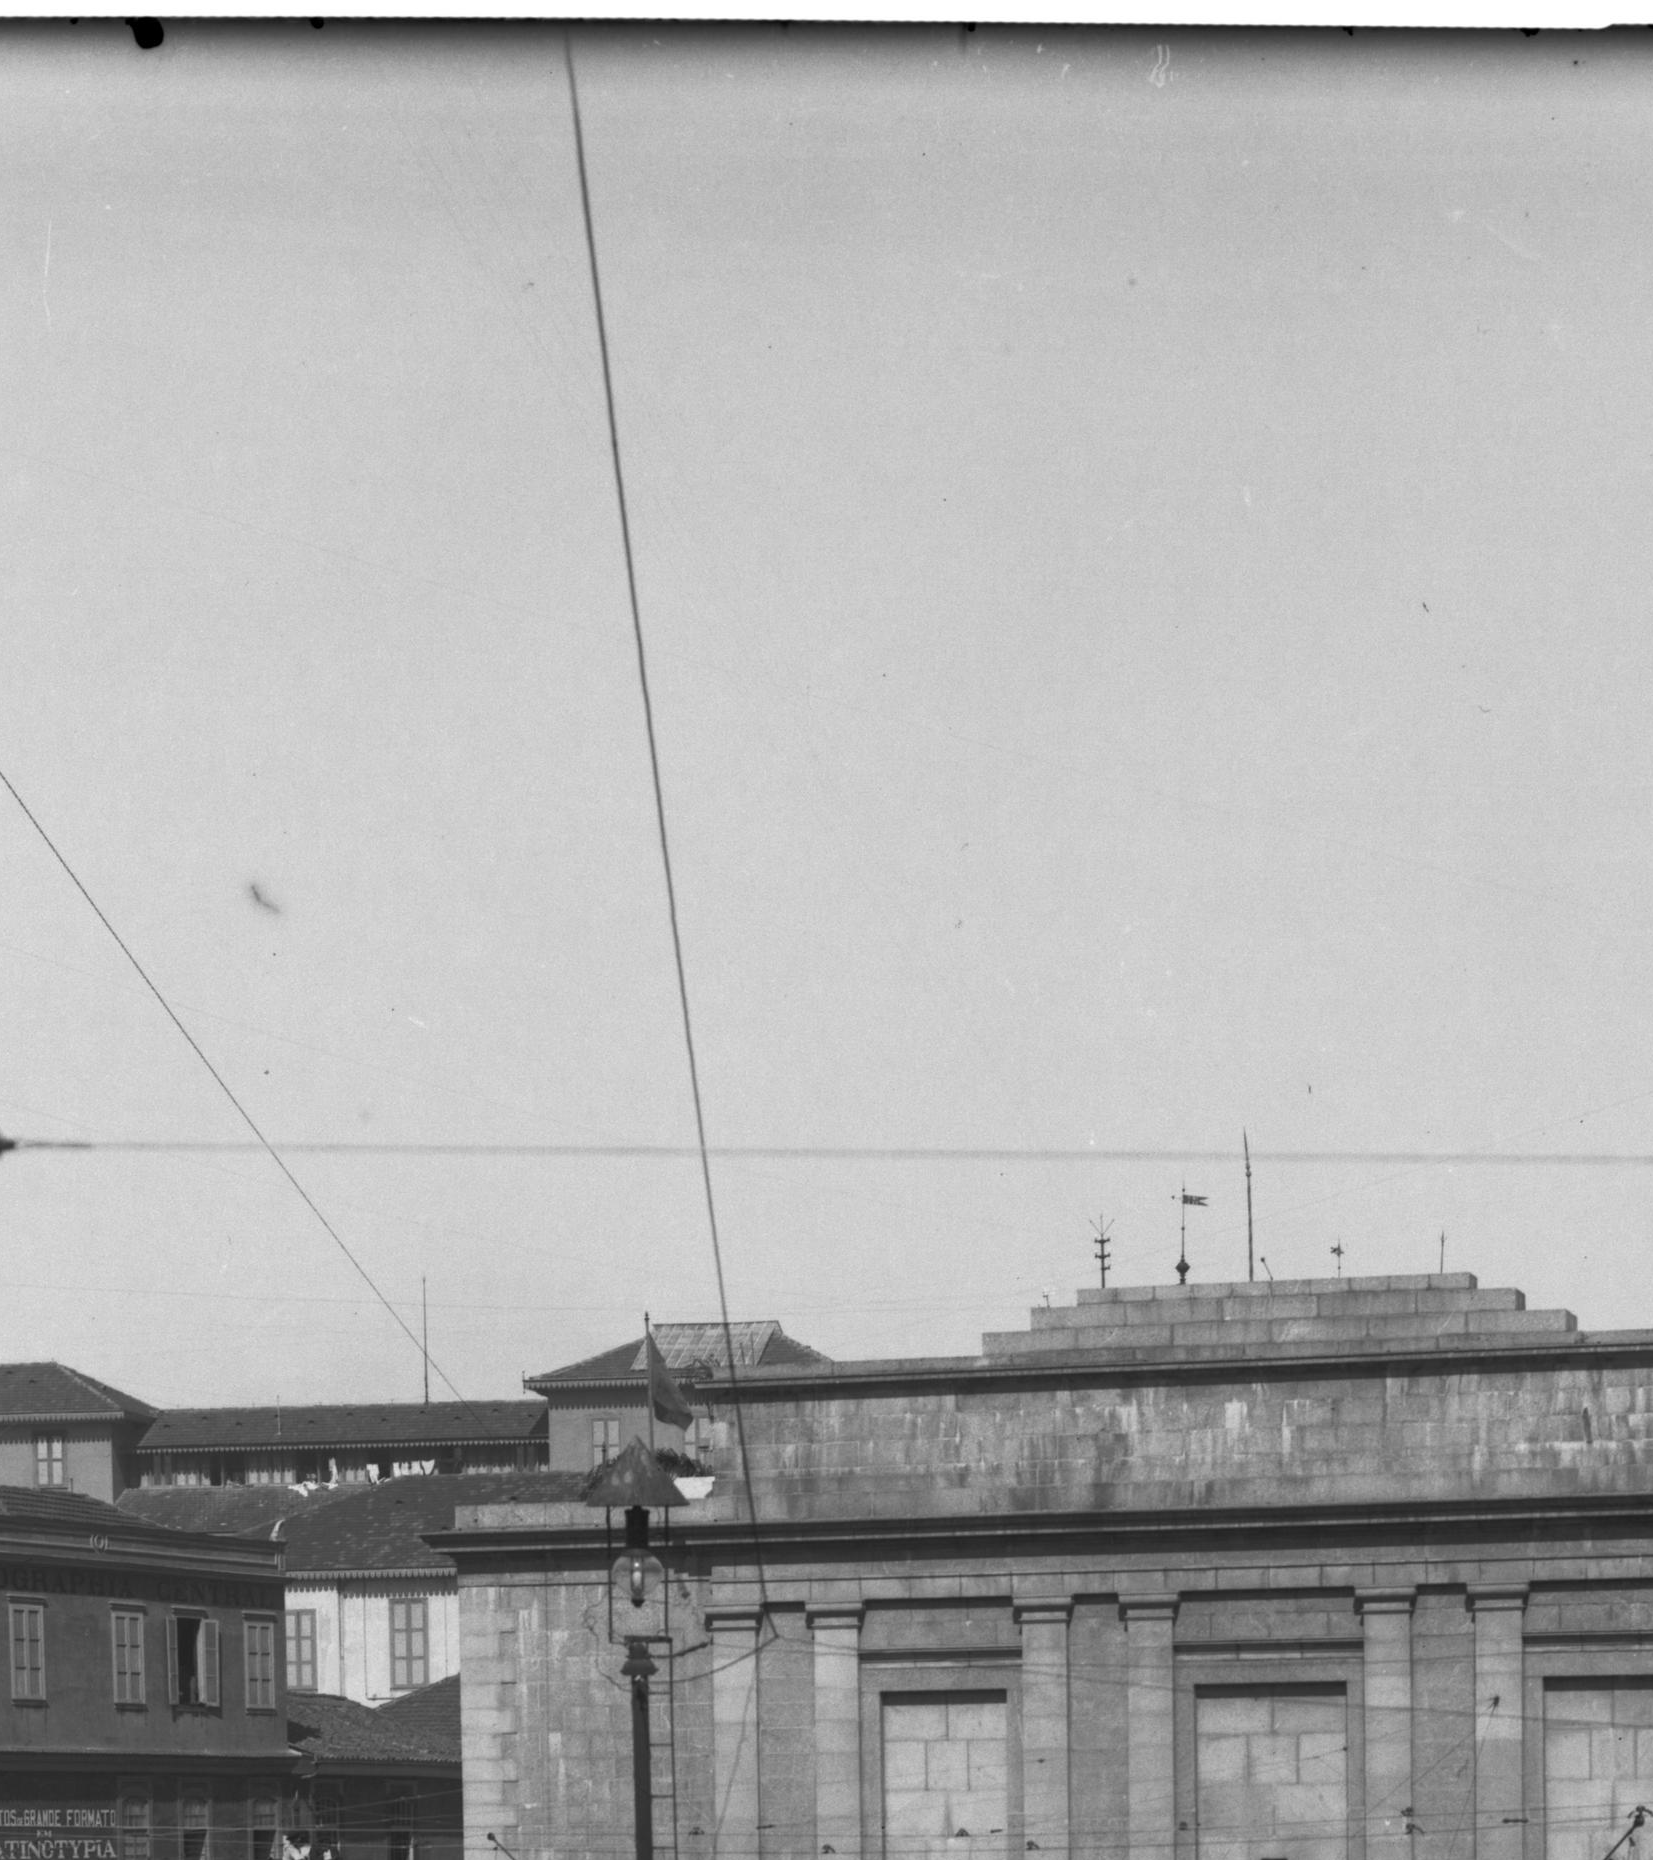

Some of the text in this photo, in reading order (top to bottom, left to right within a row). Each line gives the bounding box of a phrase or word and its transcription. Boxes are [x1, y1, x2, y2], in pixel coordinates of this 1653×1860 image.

[156, 1580, 278, 1608] CENTRAL
[24, 1809, 62, 1827] GRANDE
[66, 1809, 116, 1827] FORMATO
